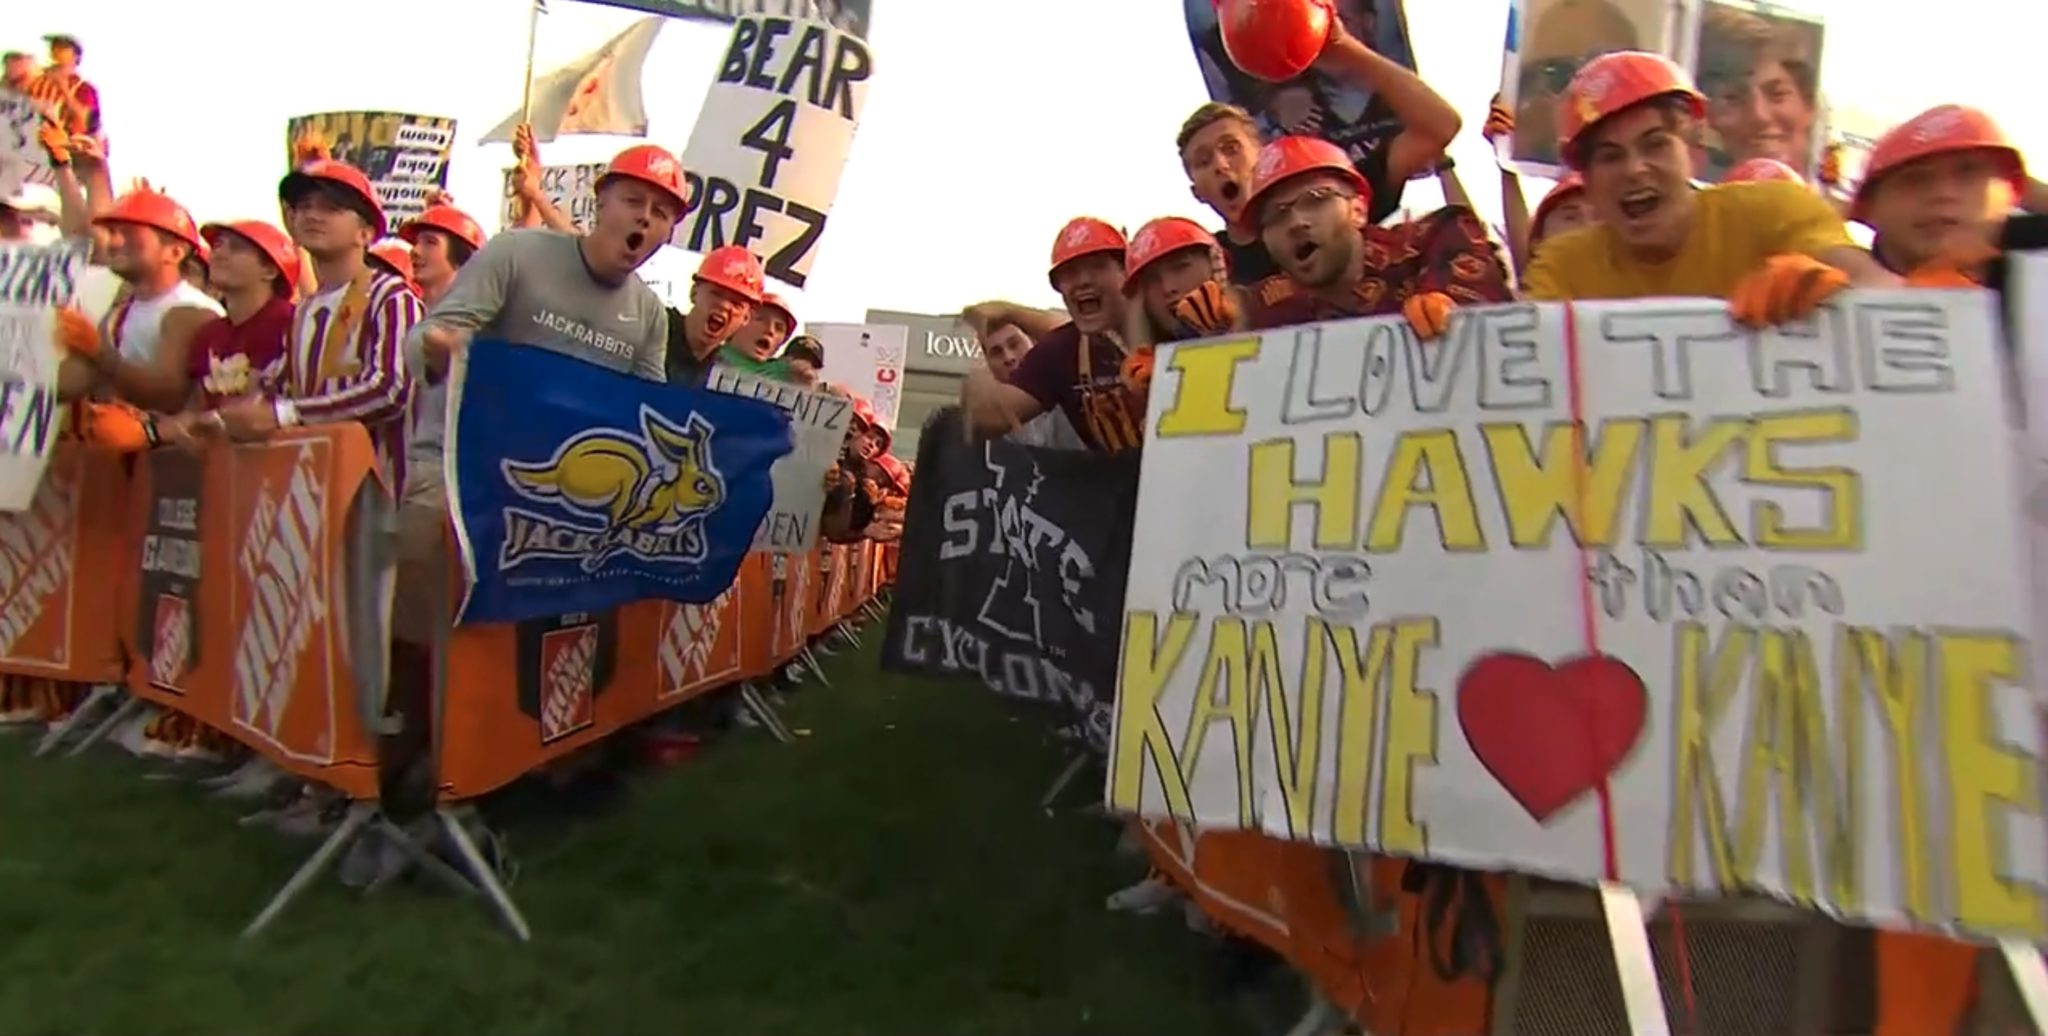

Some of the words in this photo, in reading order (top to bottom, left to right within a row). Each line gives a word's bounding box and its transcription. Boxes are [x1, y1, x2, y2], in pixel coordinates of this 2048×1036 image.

[717, 16, 873, 120] BEAR
[397, 158, 437, 174] fake
[400, 129, 446, 146] team
[741, 99, 797, 190] 4
[376, 187, 427, 201] noth
[532, 308, 635, 360] JACKRABBITS
[926, 331, 986, 358] IOWA
[1156, 335, 1262, 438] I
[1280, 304, 1552, 425] LOVE
[1602, 301, 1956, 399] THE
[1246, 406, 1865, 552] HAWKS
[939, 488, 1096, 634] STATE
[1173, 553, 1374, 621] more
[1588, 549, 1845, 623] than
[1112, 610, 1443, 857] KANYE
[1664, 621, 2048, 939] KANYE
